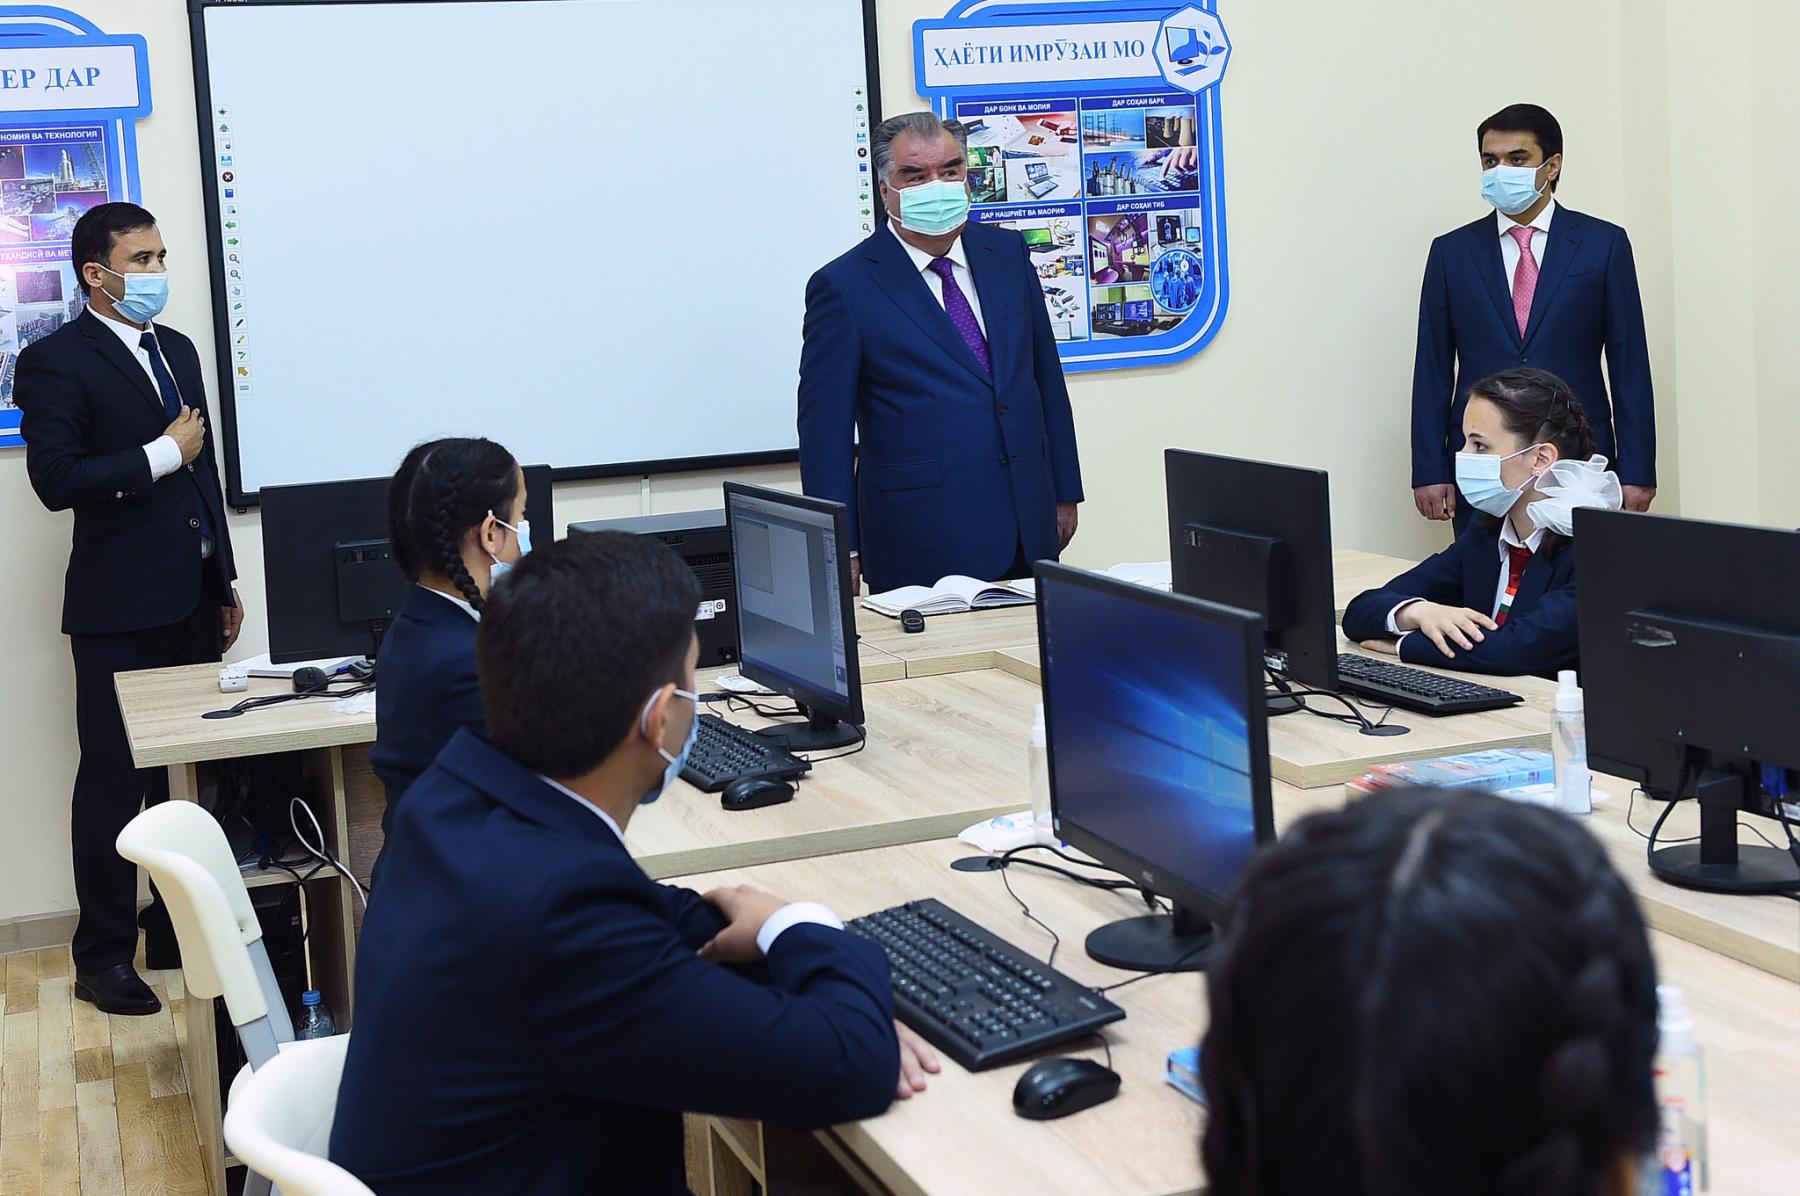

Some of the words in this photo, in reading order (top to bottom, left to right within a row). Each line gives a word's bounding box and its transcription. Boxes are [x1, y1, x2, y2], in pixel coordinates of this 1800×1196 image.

[934, 42, 1003, 69] ҲАЁТИ
[1009, 38, 1107, 62] ИМРӮЗАИ
[1113, 39, 1145, 59] МО
[45, 67, 101, 93] ДАР
[1112, 99, 1125, 107] ДАР
[984, 106, 998, 114] ДАР
[32, 132, 42, 140] ВА
[45, 130, 98, 140] ТЕХНОЛОГИЯ
[1117, 203, 1130, 211] ДАР
[980, 212, 994, 220] ДАР
[1038, 207, 1066, 215] МАОРИФ
[45, 250, 57, 258] ВА
